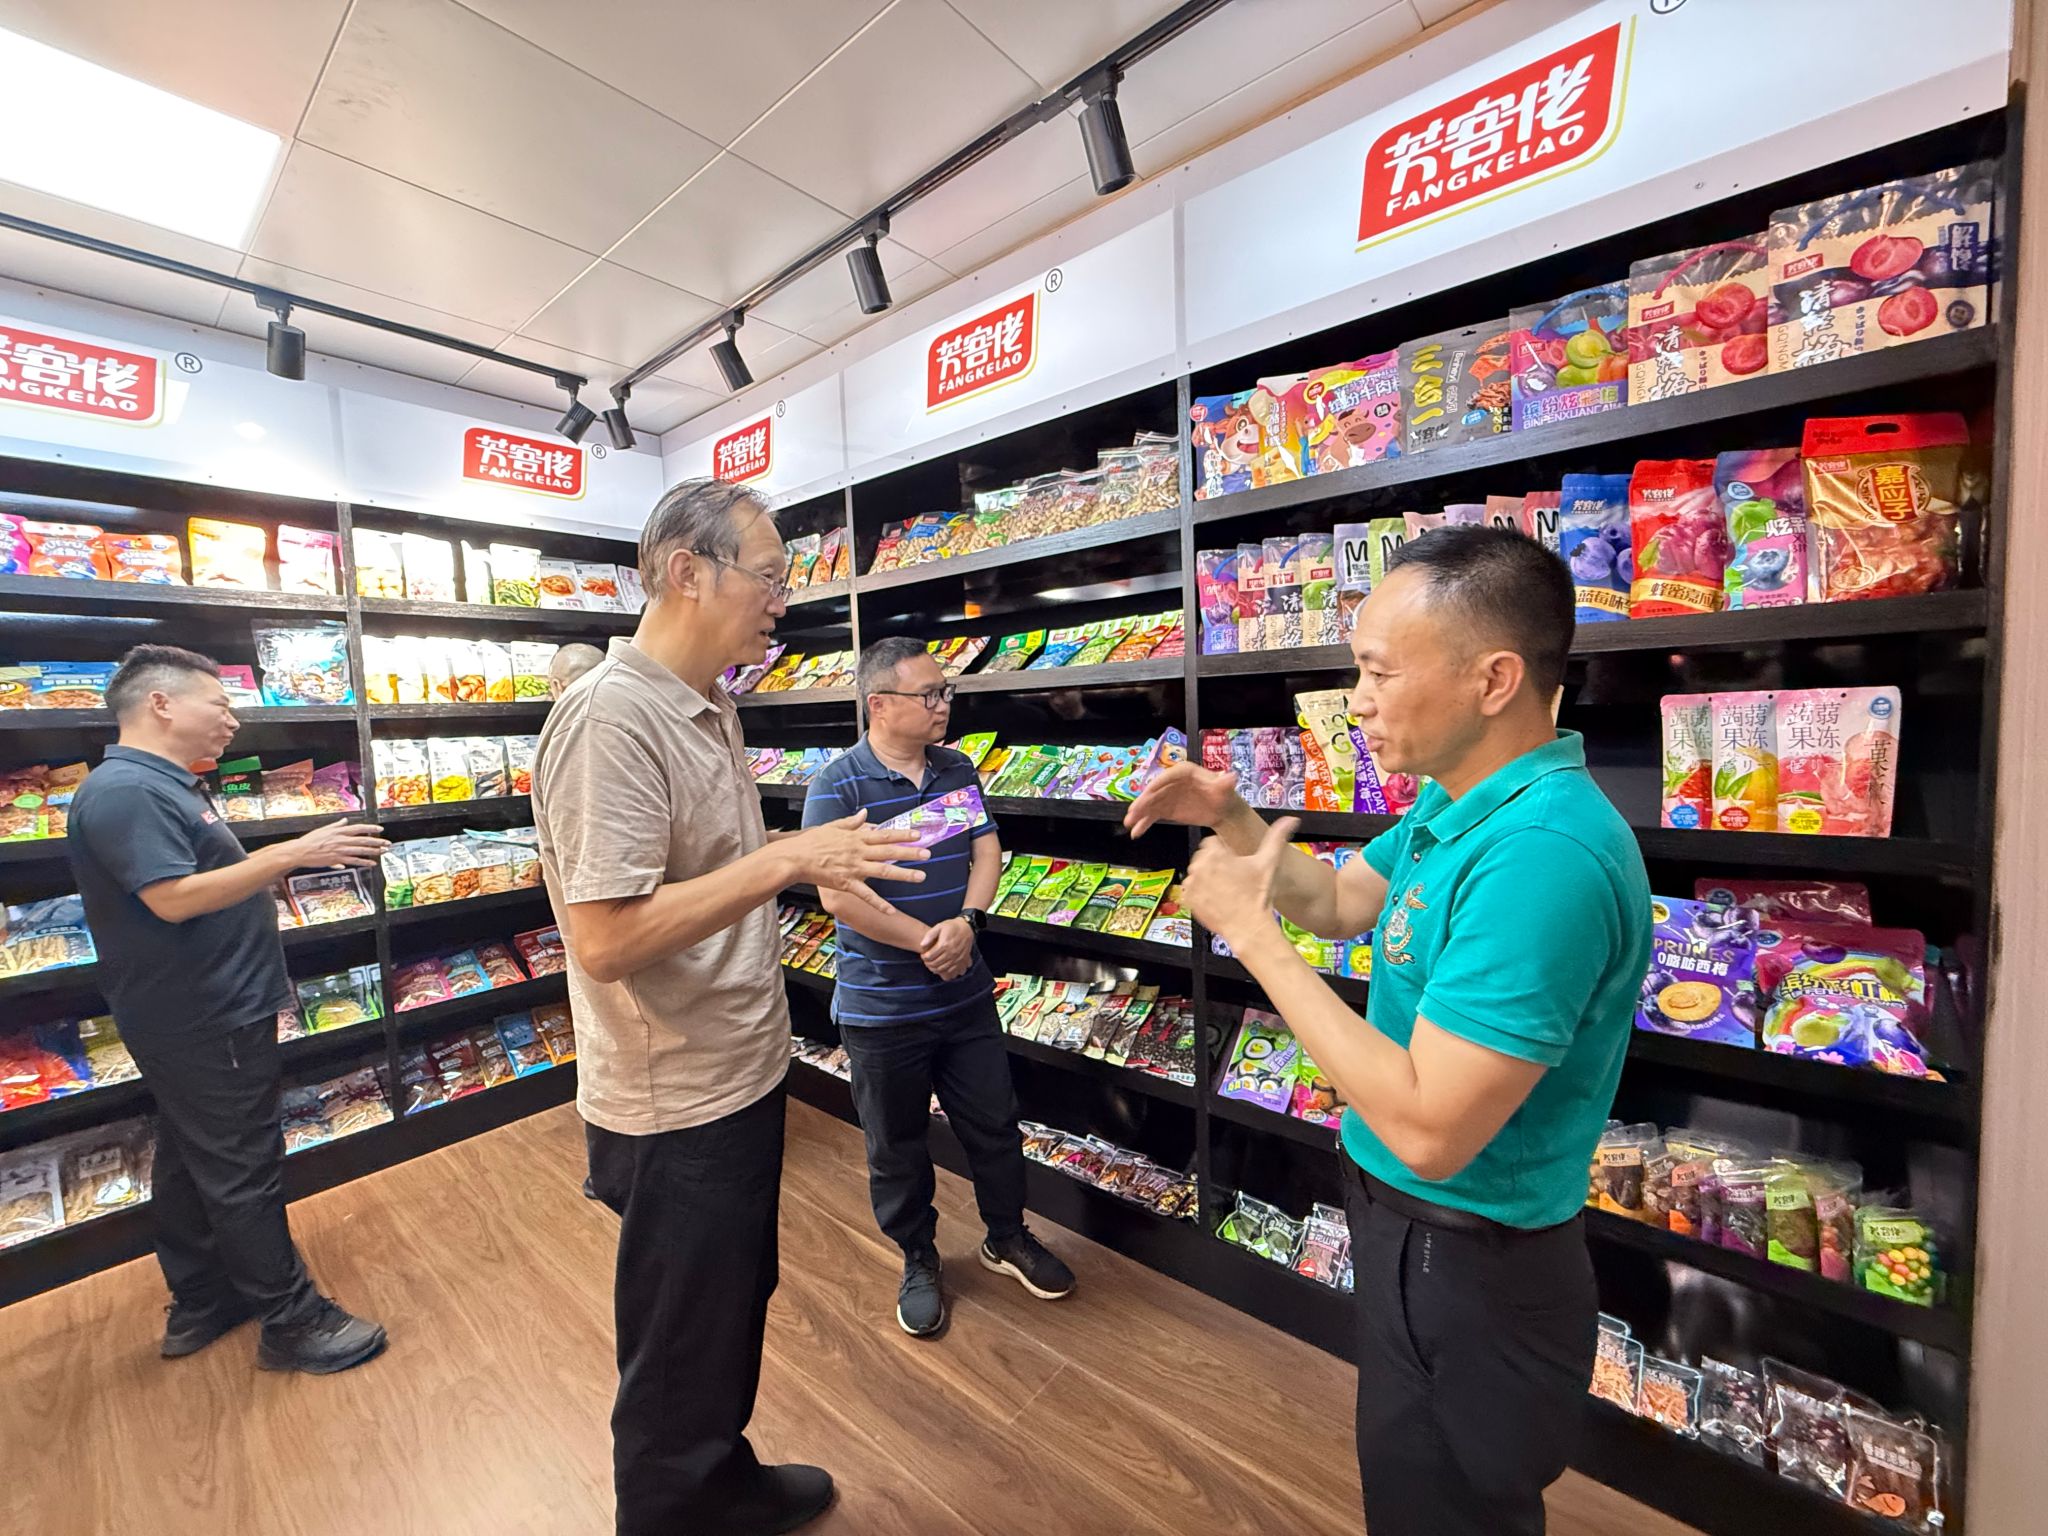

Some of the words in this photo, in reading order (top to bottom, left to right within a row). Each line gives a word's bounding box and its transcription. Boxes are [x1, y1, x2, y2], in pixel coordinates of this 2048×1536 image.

[1383, 53, 1595, 196] 芳客佬
[1385, 124, 1585, 217] FANGKELAO
[936, 309, 1025, 381] 芳客佬
[938, 352, 1023, 395] FANGKELAO
[475, 434, 574, 479] 芳客佬
[717, 426, 767, 470] 芳客佬
[479, 465, 573, 490] FANGKELAO
[1875, 465, 1914, 520] 嘉应子
[1350, 729, 1372, 759] ENJOY
[1365, 758, 1381, 790] EVERY
[1670, 728, 1713, 750] 果冻
[1721, 727, 1768, 750] 果冻
[1788, 726, 1841, 750] 果冻
[1303, 733, 1323, 763] ENJOY
[1316, 760, 1333, 789] EVERY
